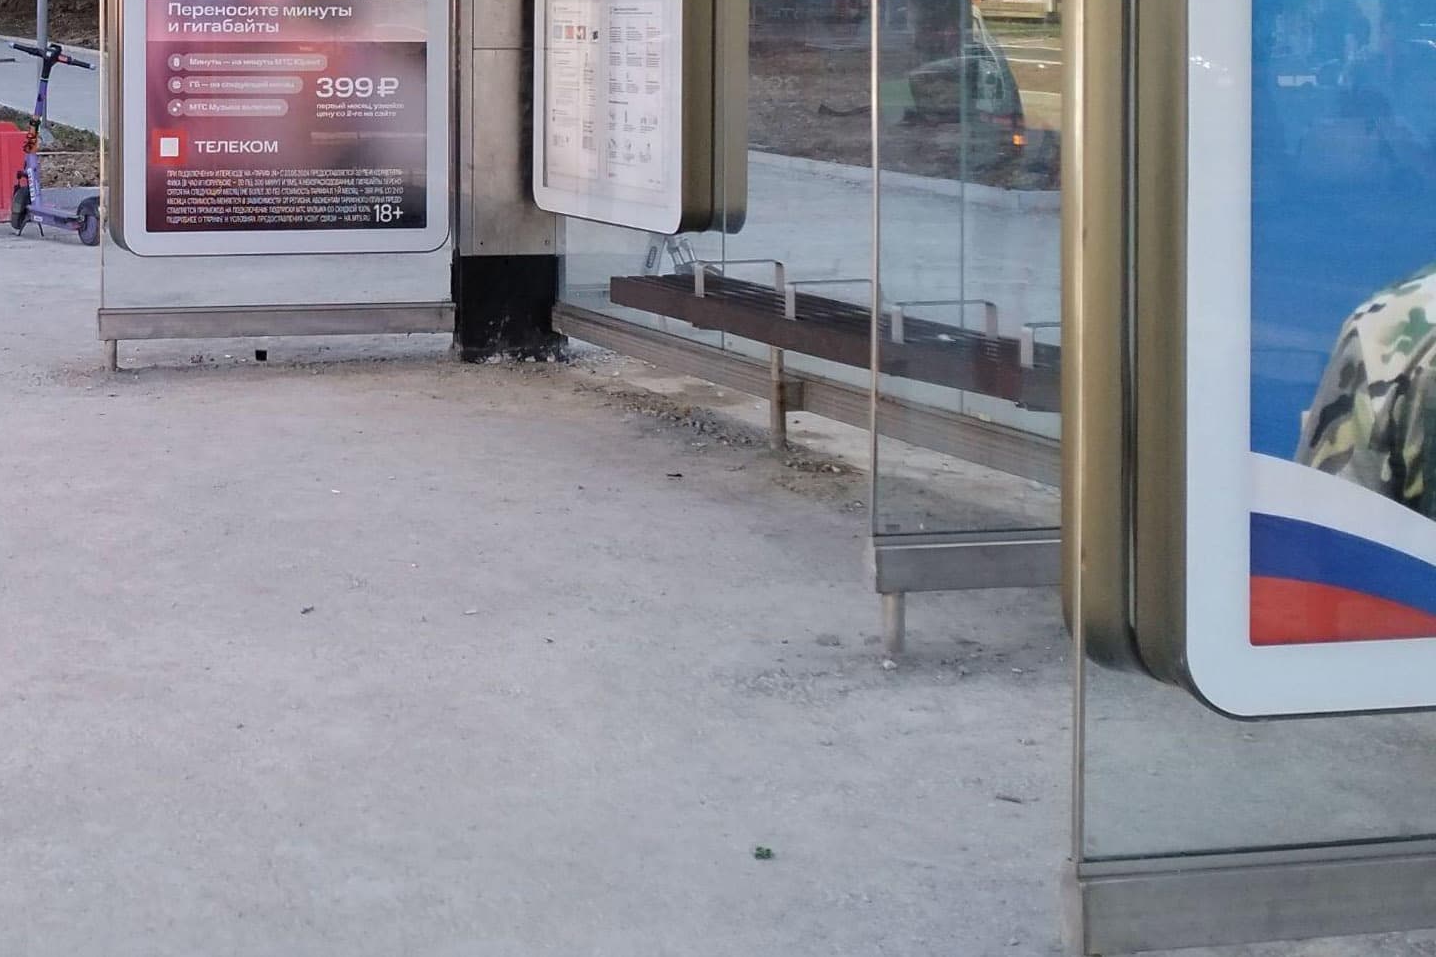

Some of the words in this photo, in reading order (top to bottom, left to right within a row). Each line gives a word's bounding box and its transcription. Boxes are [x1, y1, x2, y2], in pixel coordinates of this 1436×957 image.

[168, 3, 279, 20] Переносите
[283, 6, 352, 20] минуты
[168, 22, 179, 33] и
[183, 19, 280, 33] гигабайты
[316, 77, 374, 98] 399
[194, 140, 279, 154] ТЕЛЕКОМ
[373, 203, 404, 223] 18+
